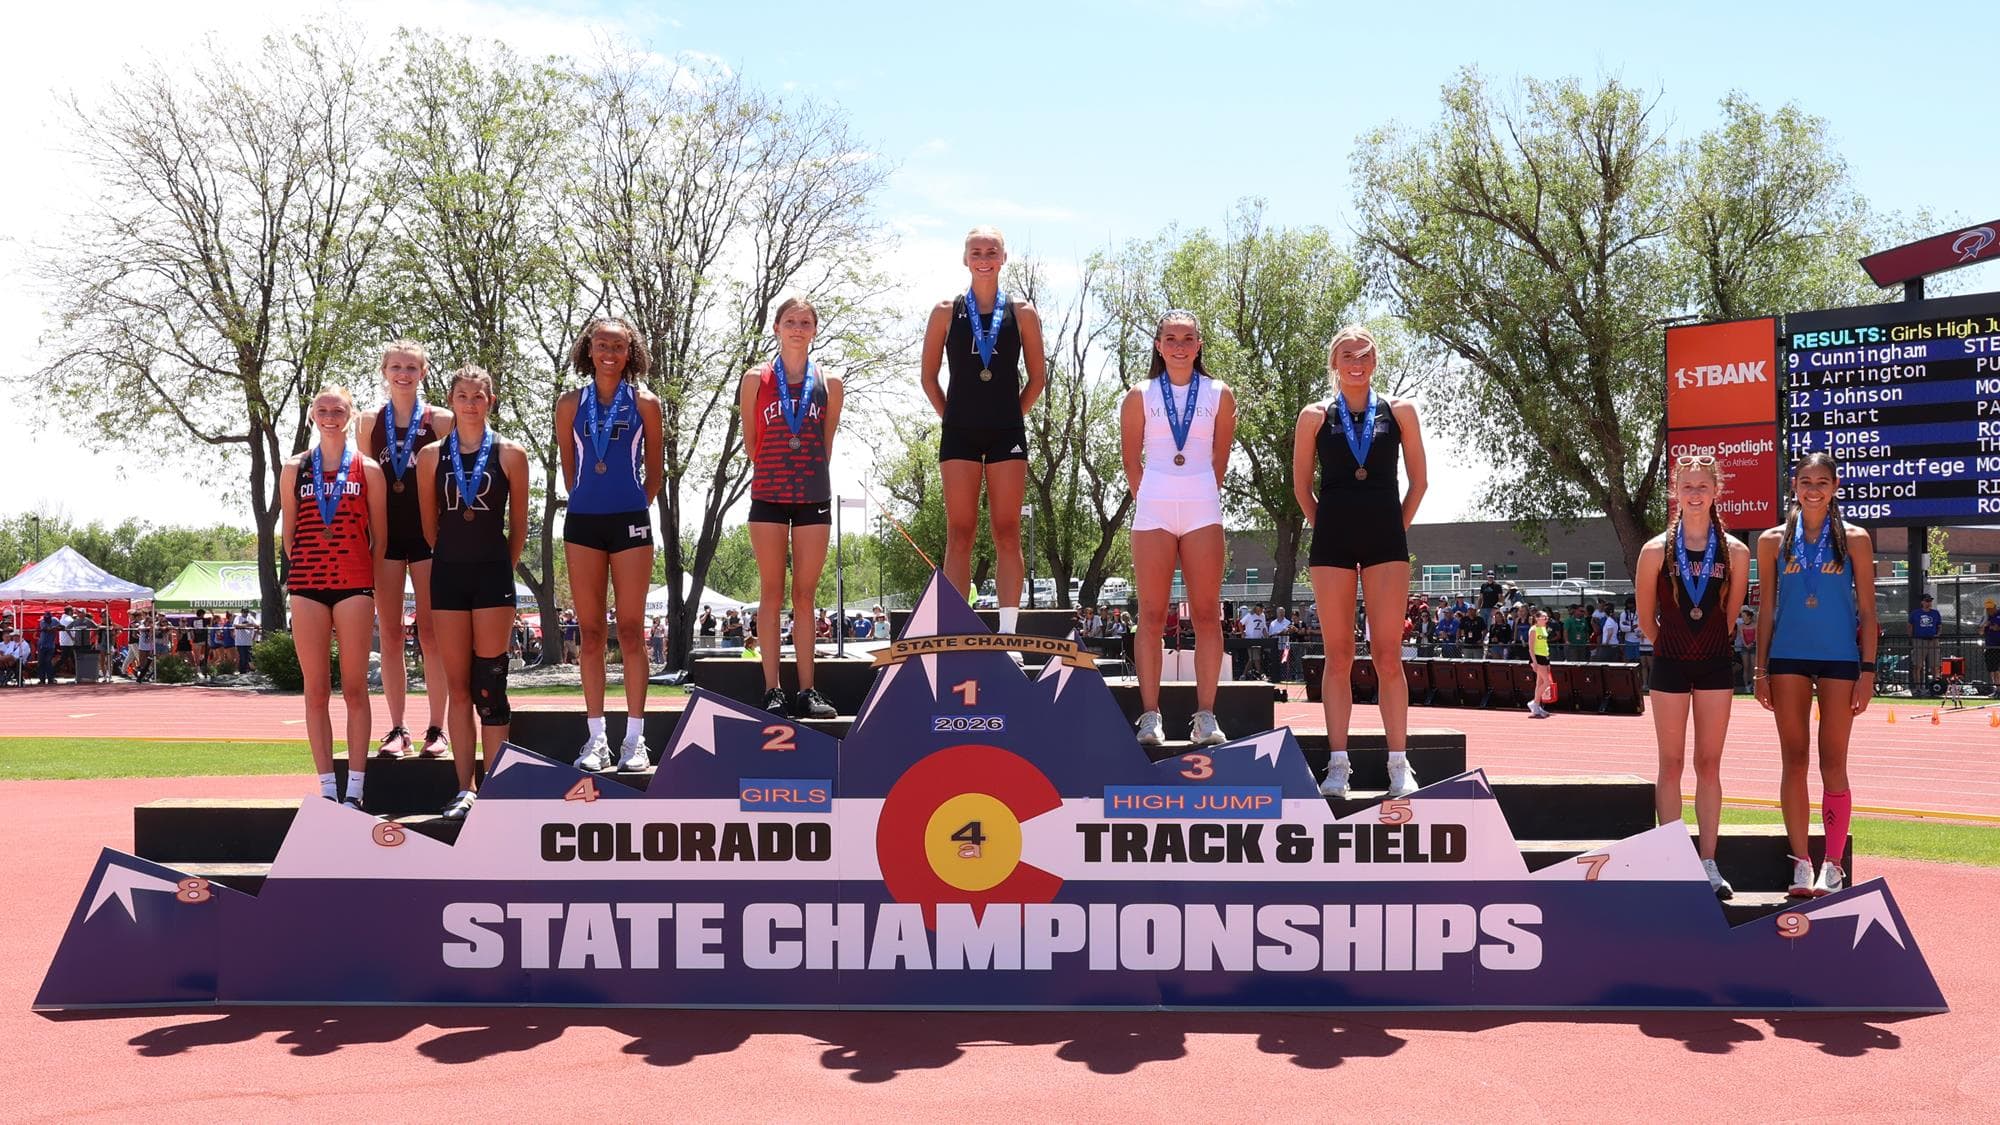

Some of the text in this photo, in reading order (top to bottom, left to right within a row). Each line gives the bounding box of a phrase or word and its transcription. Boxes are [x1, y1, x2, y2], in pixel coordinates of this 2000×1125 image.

[1793, 326, 1887, 349] RESULTS:
[1891, 323, 1932, 342] Girls
[1937, 318, 1980, 339] High
[1789, 353, 1800, 369] 9
[1811, 343, 1927, 367] Cunningham
[1674, 360, 1768, 389] 1STBANK
[1790, 371, 1811, 387] 11
[1822, 364, 1927, 385] Arrington
[1790, 392, 1810, 408] 12
[1823, 386, 1903, 406] Johnson
[1790, 413, 1811, 428] 12
[1824, 408, 1879, 425] Ehart
[1671, 439, 1774, 457] CO Prep Spotlight
[1791, 432, 1813, 448] 14
[1824, 429, 1881, 446] Jones
[1835, 457, 1965, 479] chwerdtfege
[1835, 480, 1917, 500] eisbrod
[628, 525, 650, 540] LT
[896, 636, 1071, 653] STATE CHAMPION
[951, 679, 978, 706] 1
[934, 716, 1004, 731] 2026
[762, 723, 798, 751] 2
[1180, 754, 1214, 781] 3
[563, 776, 601, 804] 4
[742, 788, 827, 805] GIRLS
[1113, 794, 1273, 811] HIGH JUMP
[1378, 798, 1414, 826] 5
[371, 820, 407, 849] 6
[540, 822, 1468, 864] COLORADO TRACK & FIELD
[950, 820, 987, 846] 4
[957, 842, 982, 859] a
[1576, 854, 1611, 881] 7
[175, 876, 212, 904] 8
[441, 902, 1544, 973] STATE CHAMPIONSHIPS
[1775, 911, 1812, 939] 9
